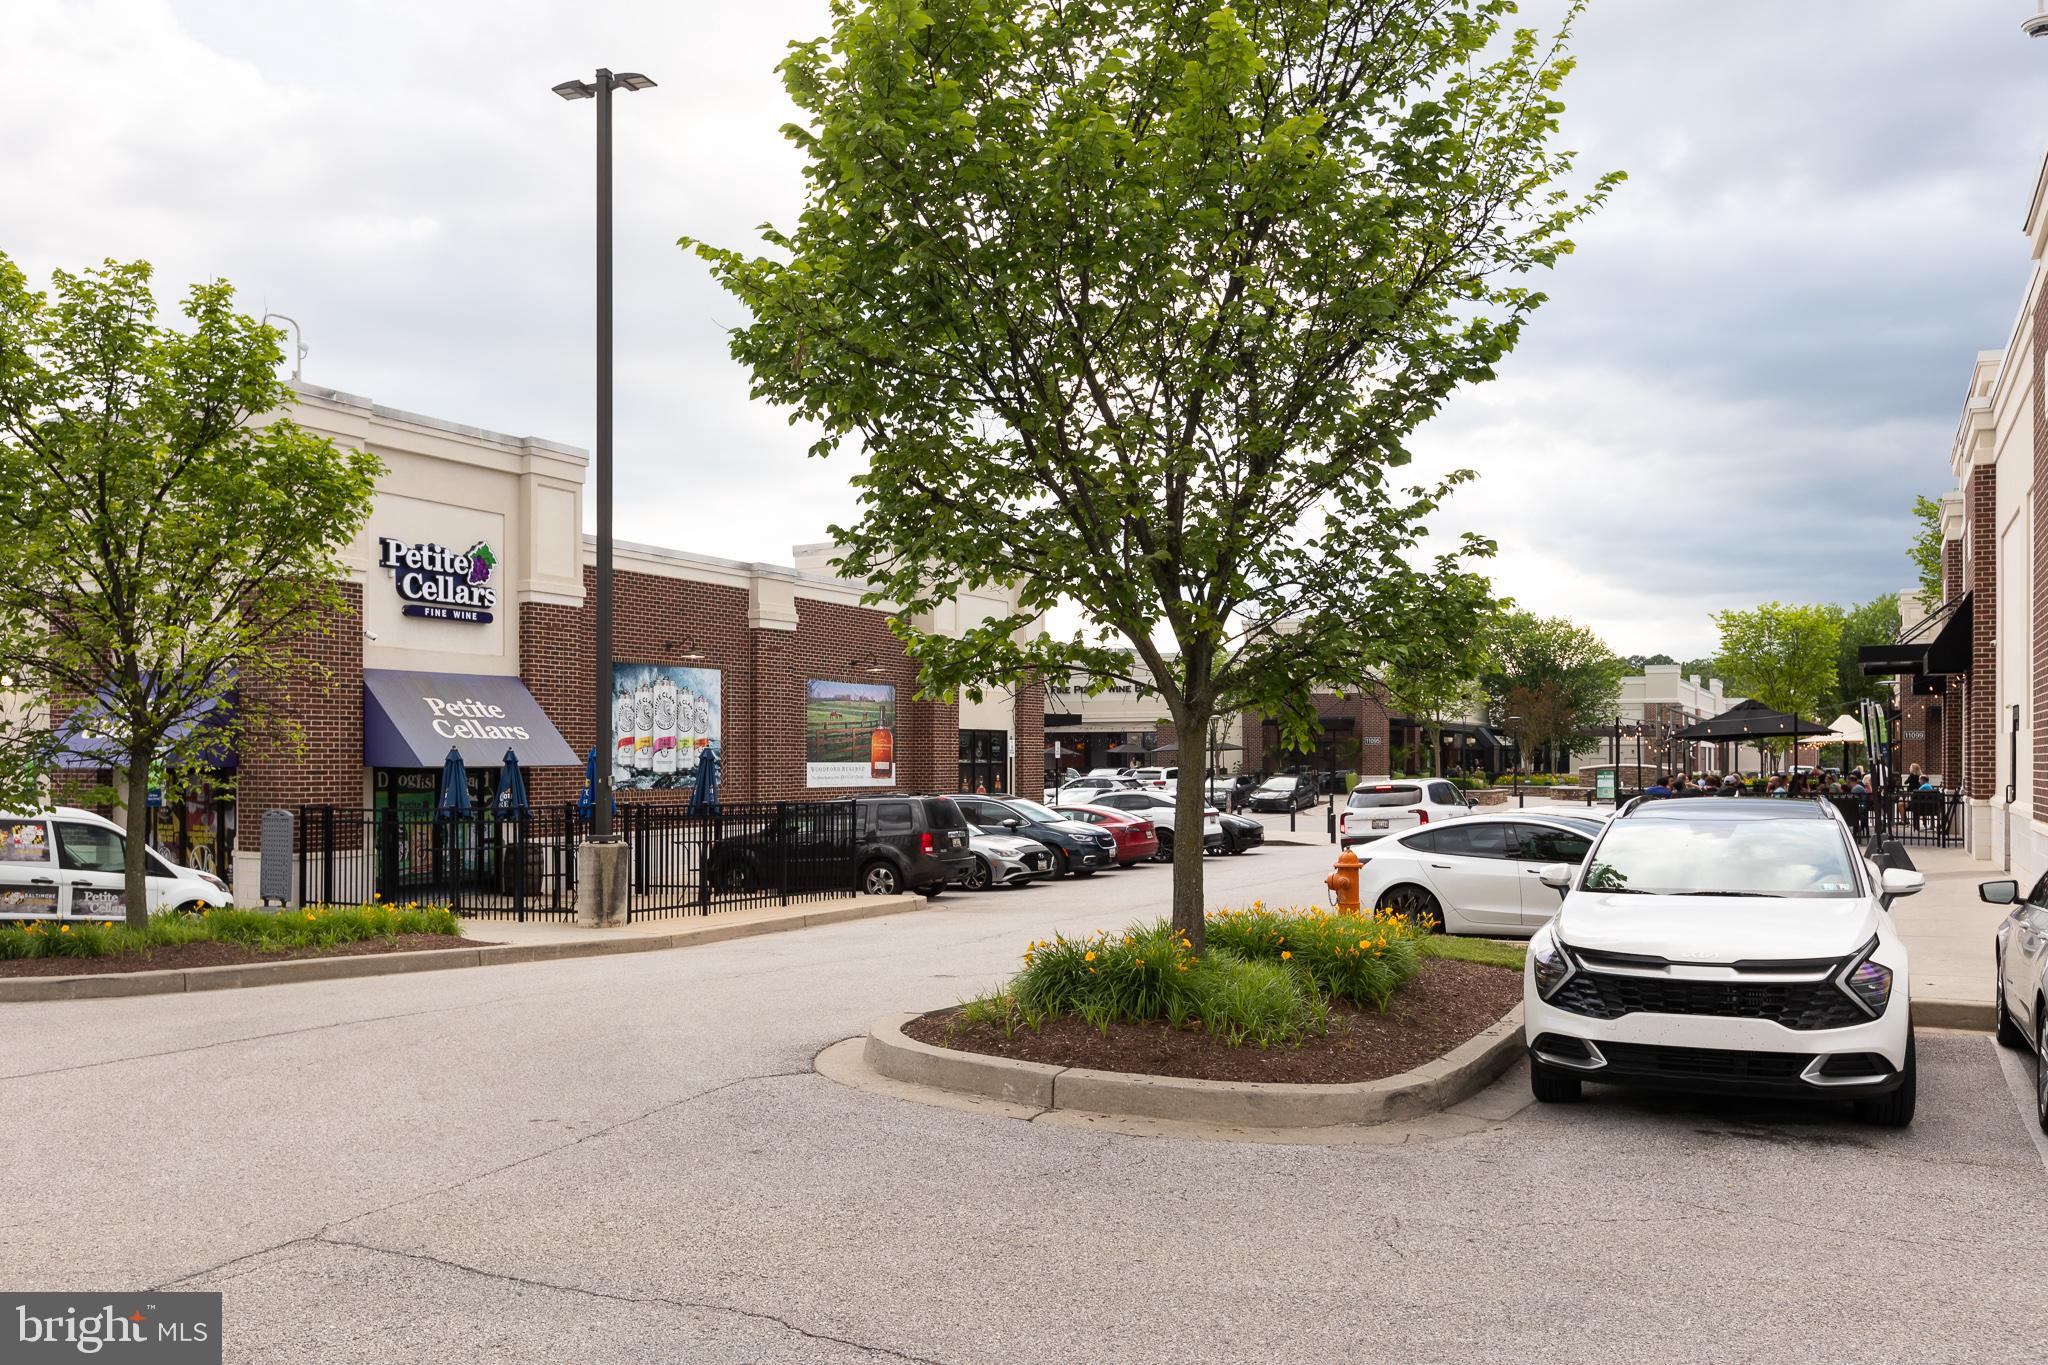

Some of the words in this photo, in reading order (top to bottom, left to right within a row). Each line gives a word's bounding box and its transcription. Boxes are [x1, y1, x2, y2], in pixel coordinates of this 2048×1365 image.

[384, 538, 470, 575] Petite
[402, 571, 497, 608] Cellars
[424, 607, 447, 618] FINE
[453, 609, 478, 621] WINE
[422, 696, 506, 720] Petite
[431, 718, 530, 741] Cellars
[84, 890, 119, 903] Petite
